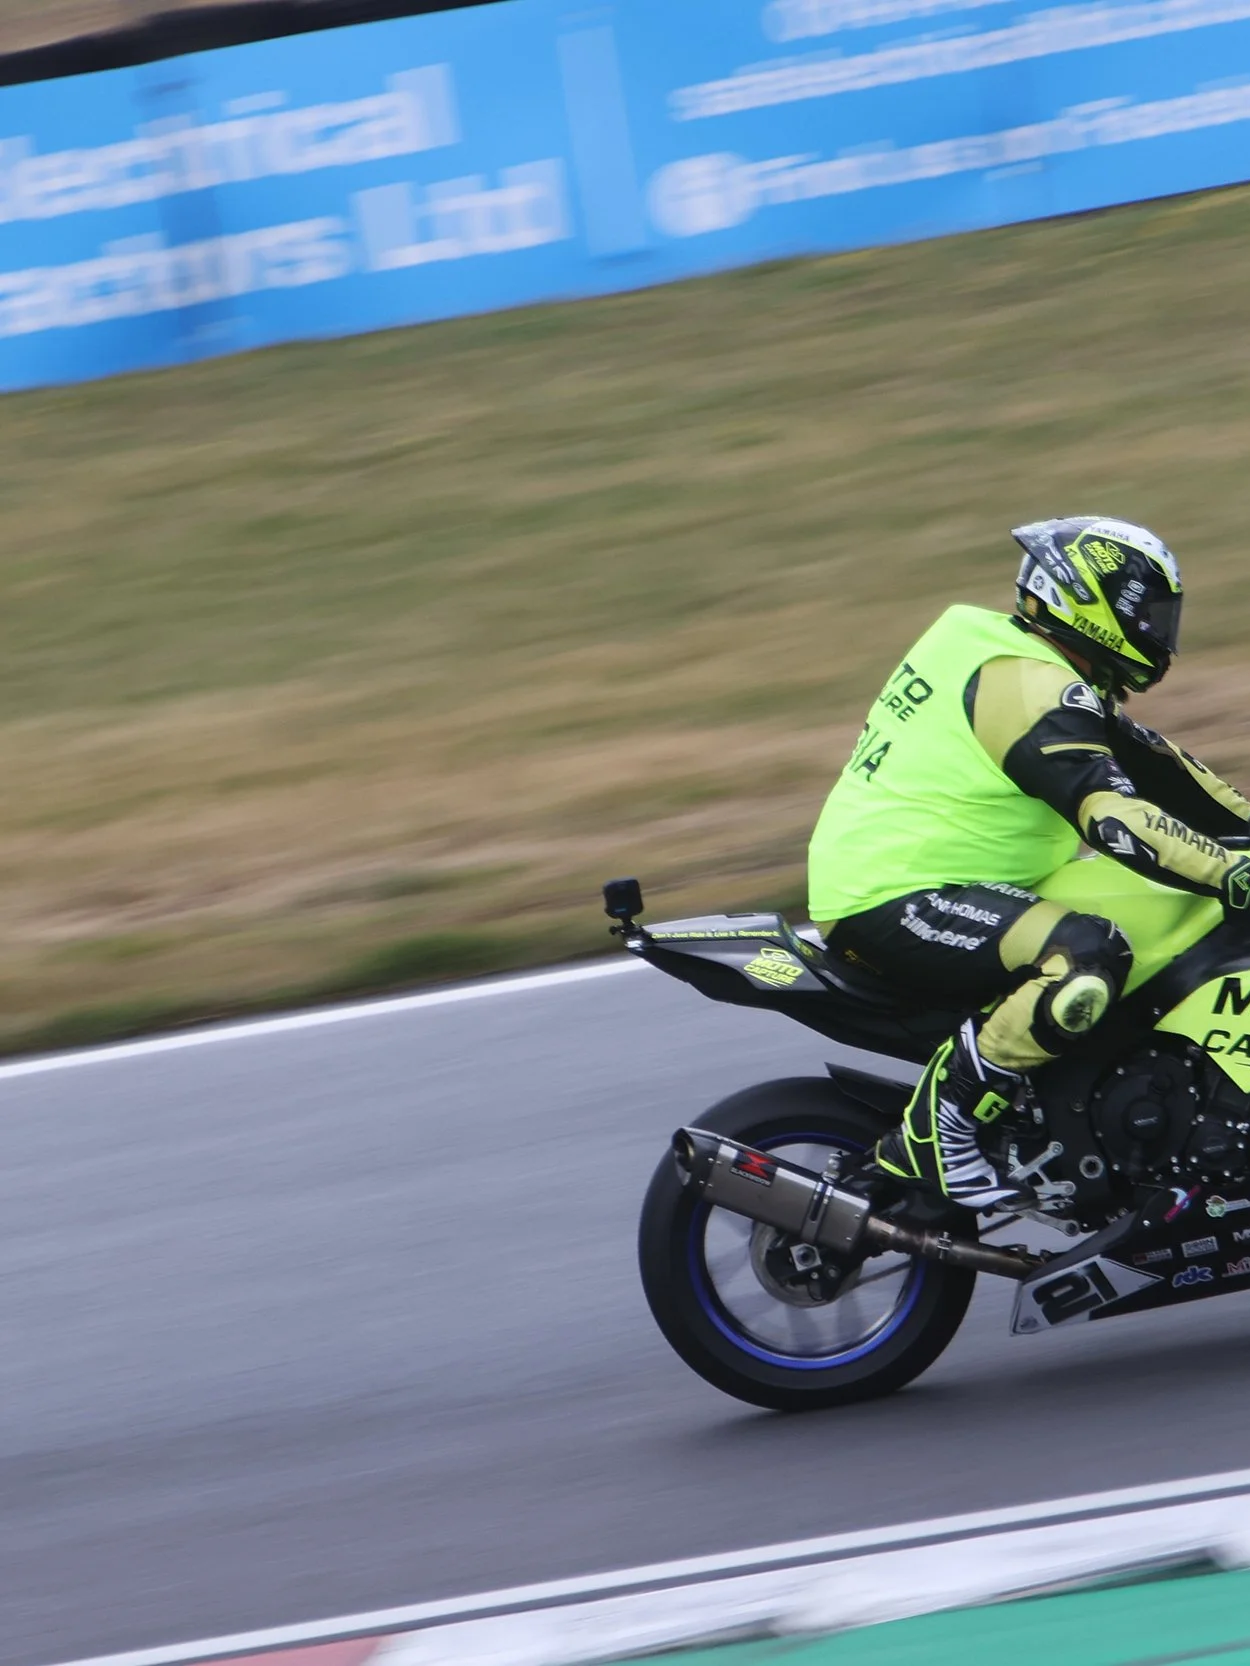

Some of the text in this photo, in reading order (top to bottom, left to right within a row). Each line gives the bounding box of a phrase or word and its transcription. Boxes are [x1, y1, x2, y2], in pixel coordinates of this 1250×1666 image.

[1072, 613, 1126, 652] YAMAHA
[1143, 810, 1229, 864] YAMAHA
[743, 964, 797, 985] CAPTURE
[749, 956, 804, 978] MOTO
[1032, 1261, 1119, 1326] 21
